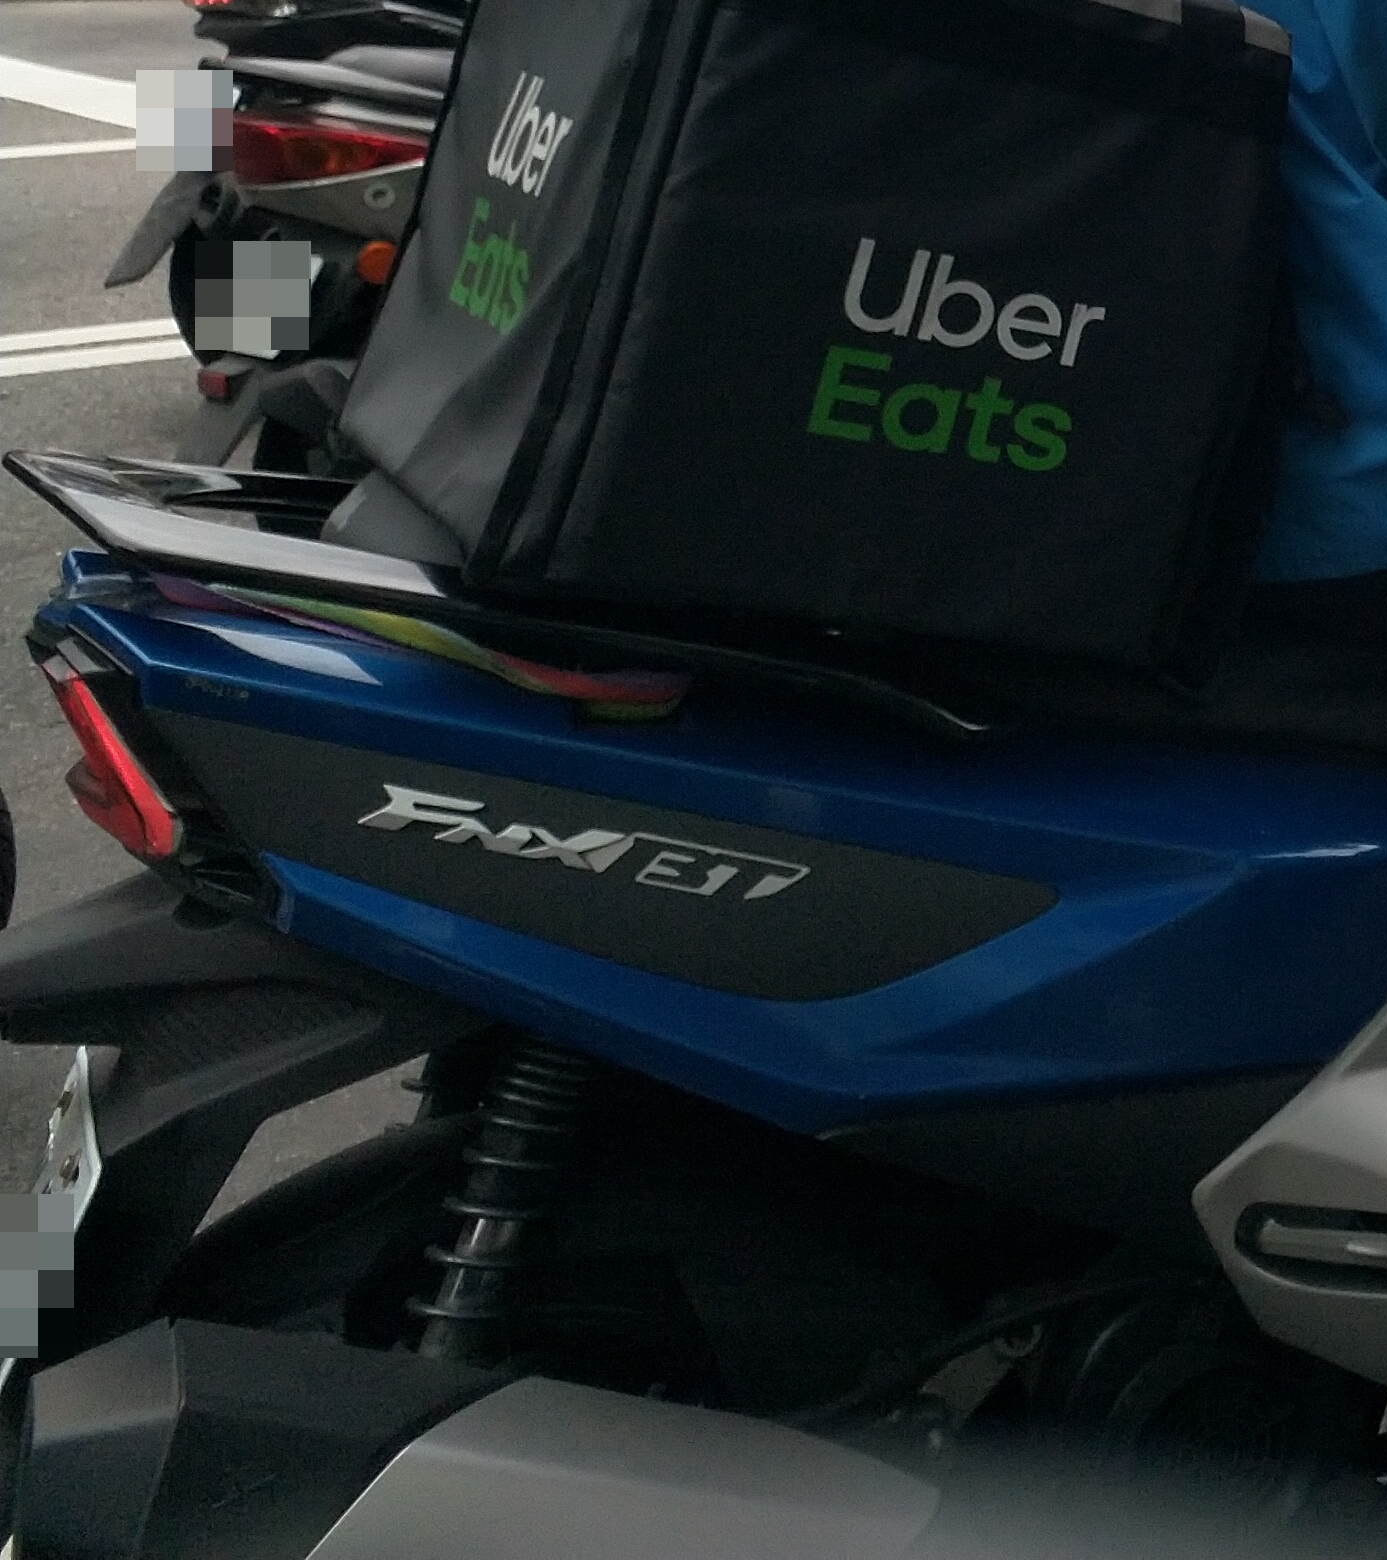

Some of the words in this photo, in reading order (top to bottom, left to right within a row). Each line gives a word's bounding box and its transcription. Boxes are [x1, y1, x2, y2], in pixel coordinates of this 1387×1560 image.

[487, 71, 573, 197] Uber
[450, 196, 528, 334] Eats
[844, 237, 1107, 367] Uber
[805, 345, 1073, 471] Eats
